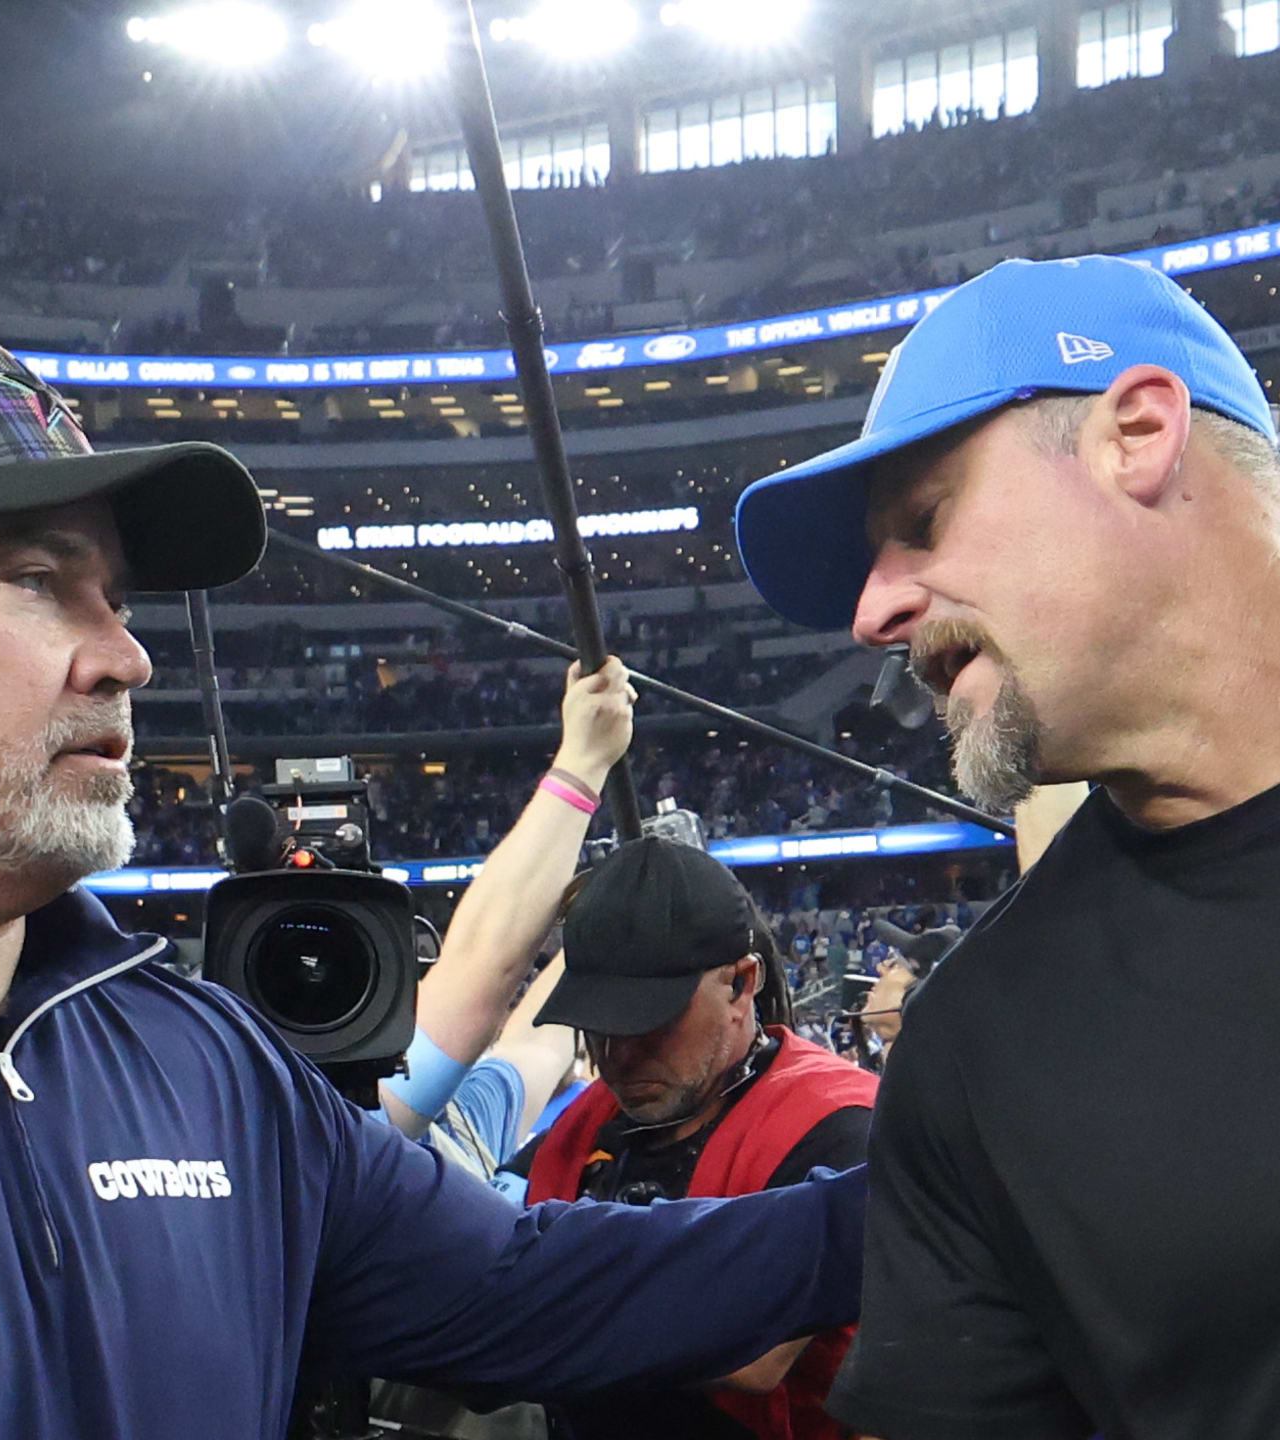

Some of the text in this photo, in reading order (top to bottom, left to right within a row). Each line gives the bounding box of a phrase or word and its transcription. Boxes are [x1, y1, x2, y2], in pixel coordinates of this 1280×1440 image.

[1162, 244, 1209, 272] FORD
[1235, 231, 1270, 257] THE
[759, 318, 823, 344] OFFICIAL
[828, 304, 892, 332] VEHICLE
[87, 1157, 232, 1201] COWBOYS
